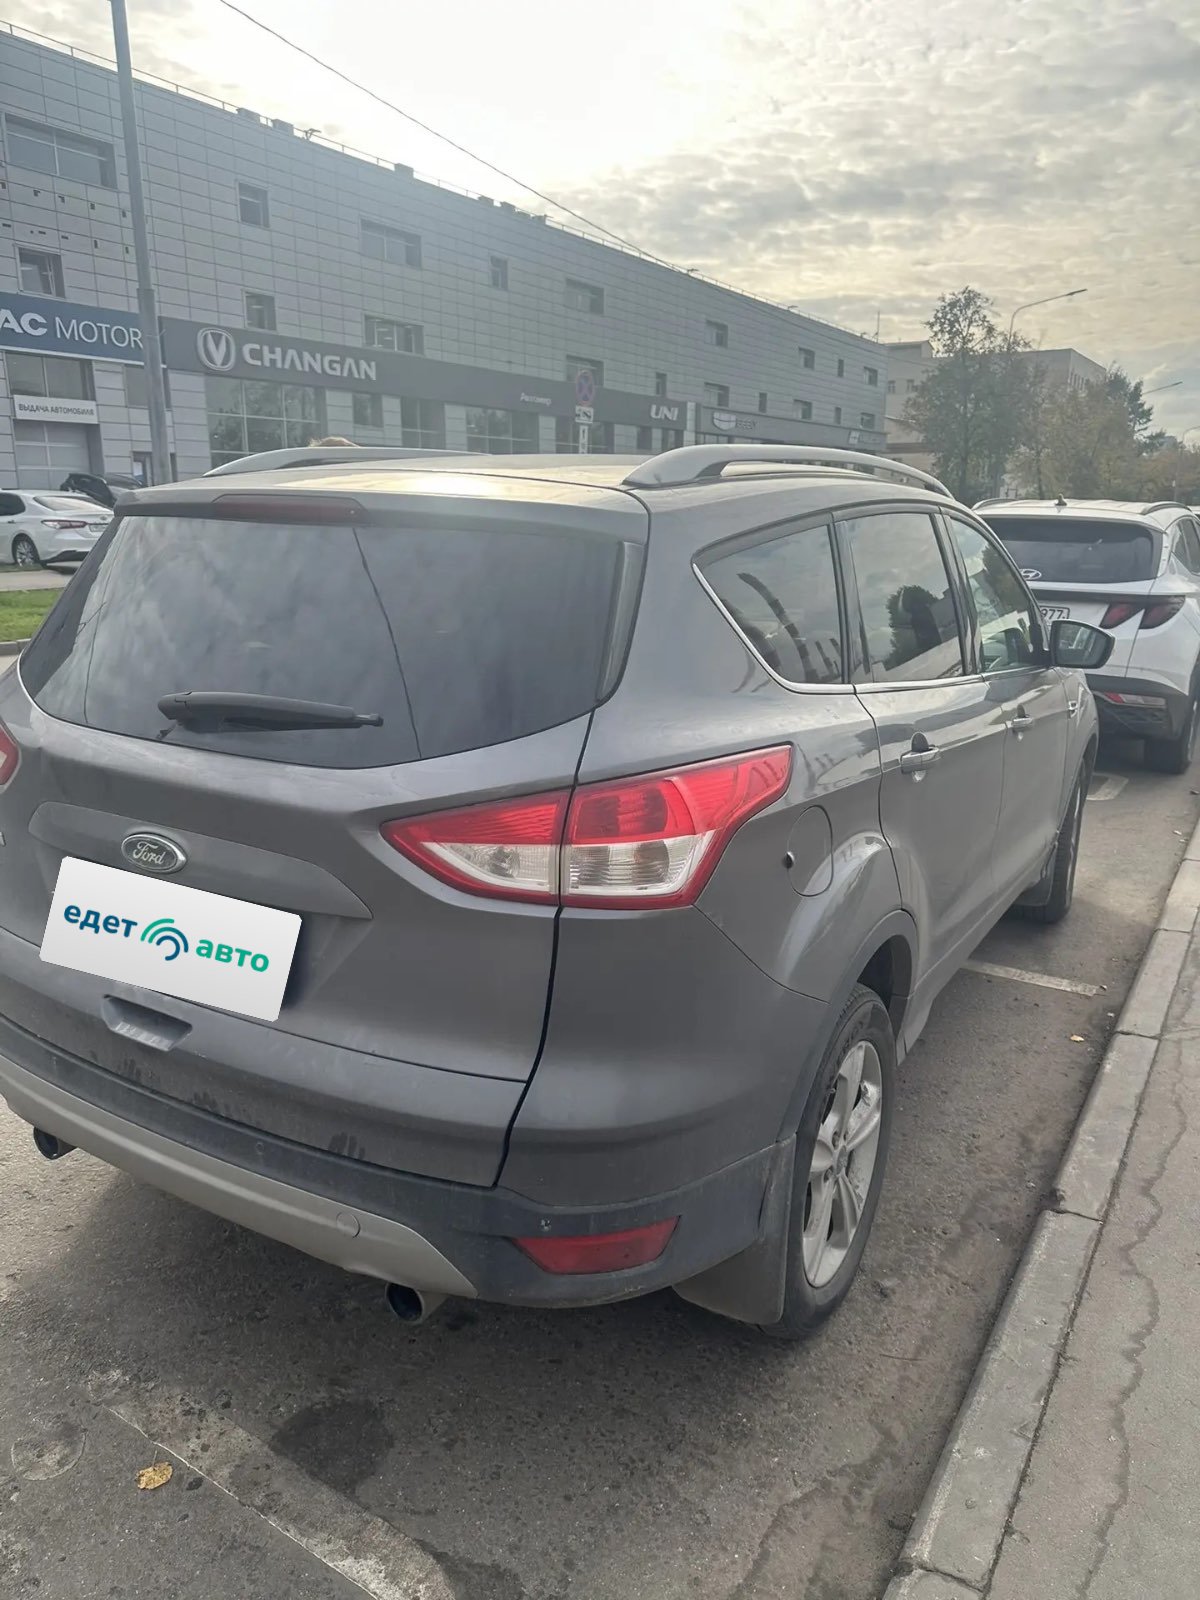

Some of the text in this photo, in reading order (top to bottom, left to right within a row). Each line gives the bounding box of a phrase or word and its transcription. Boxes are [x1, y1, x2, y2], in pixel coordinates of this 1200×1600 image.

[55, 316, 144, 349] MOTOR
[242, 342, 377, 381] CHANGAN
[18, 403, 95, 416] ВЫДАЧА АВТОМОБИЛЯ
[650, 403, 679, 421] UNI
[132, 840, 165, 866] Ford
